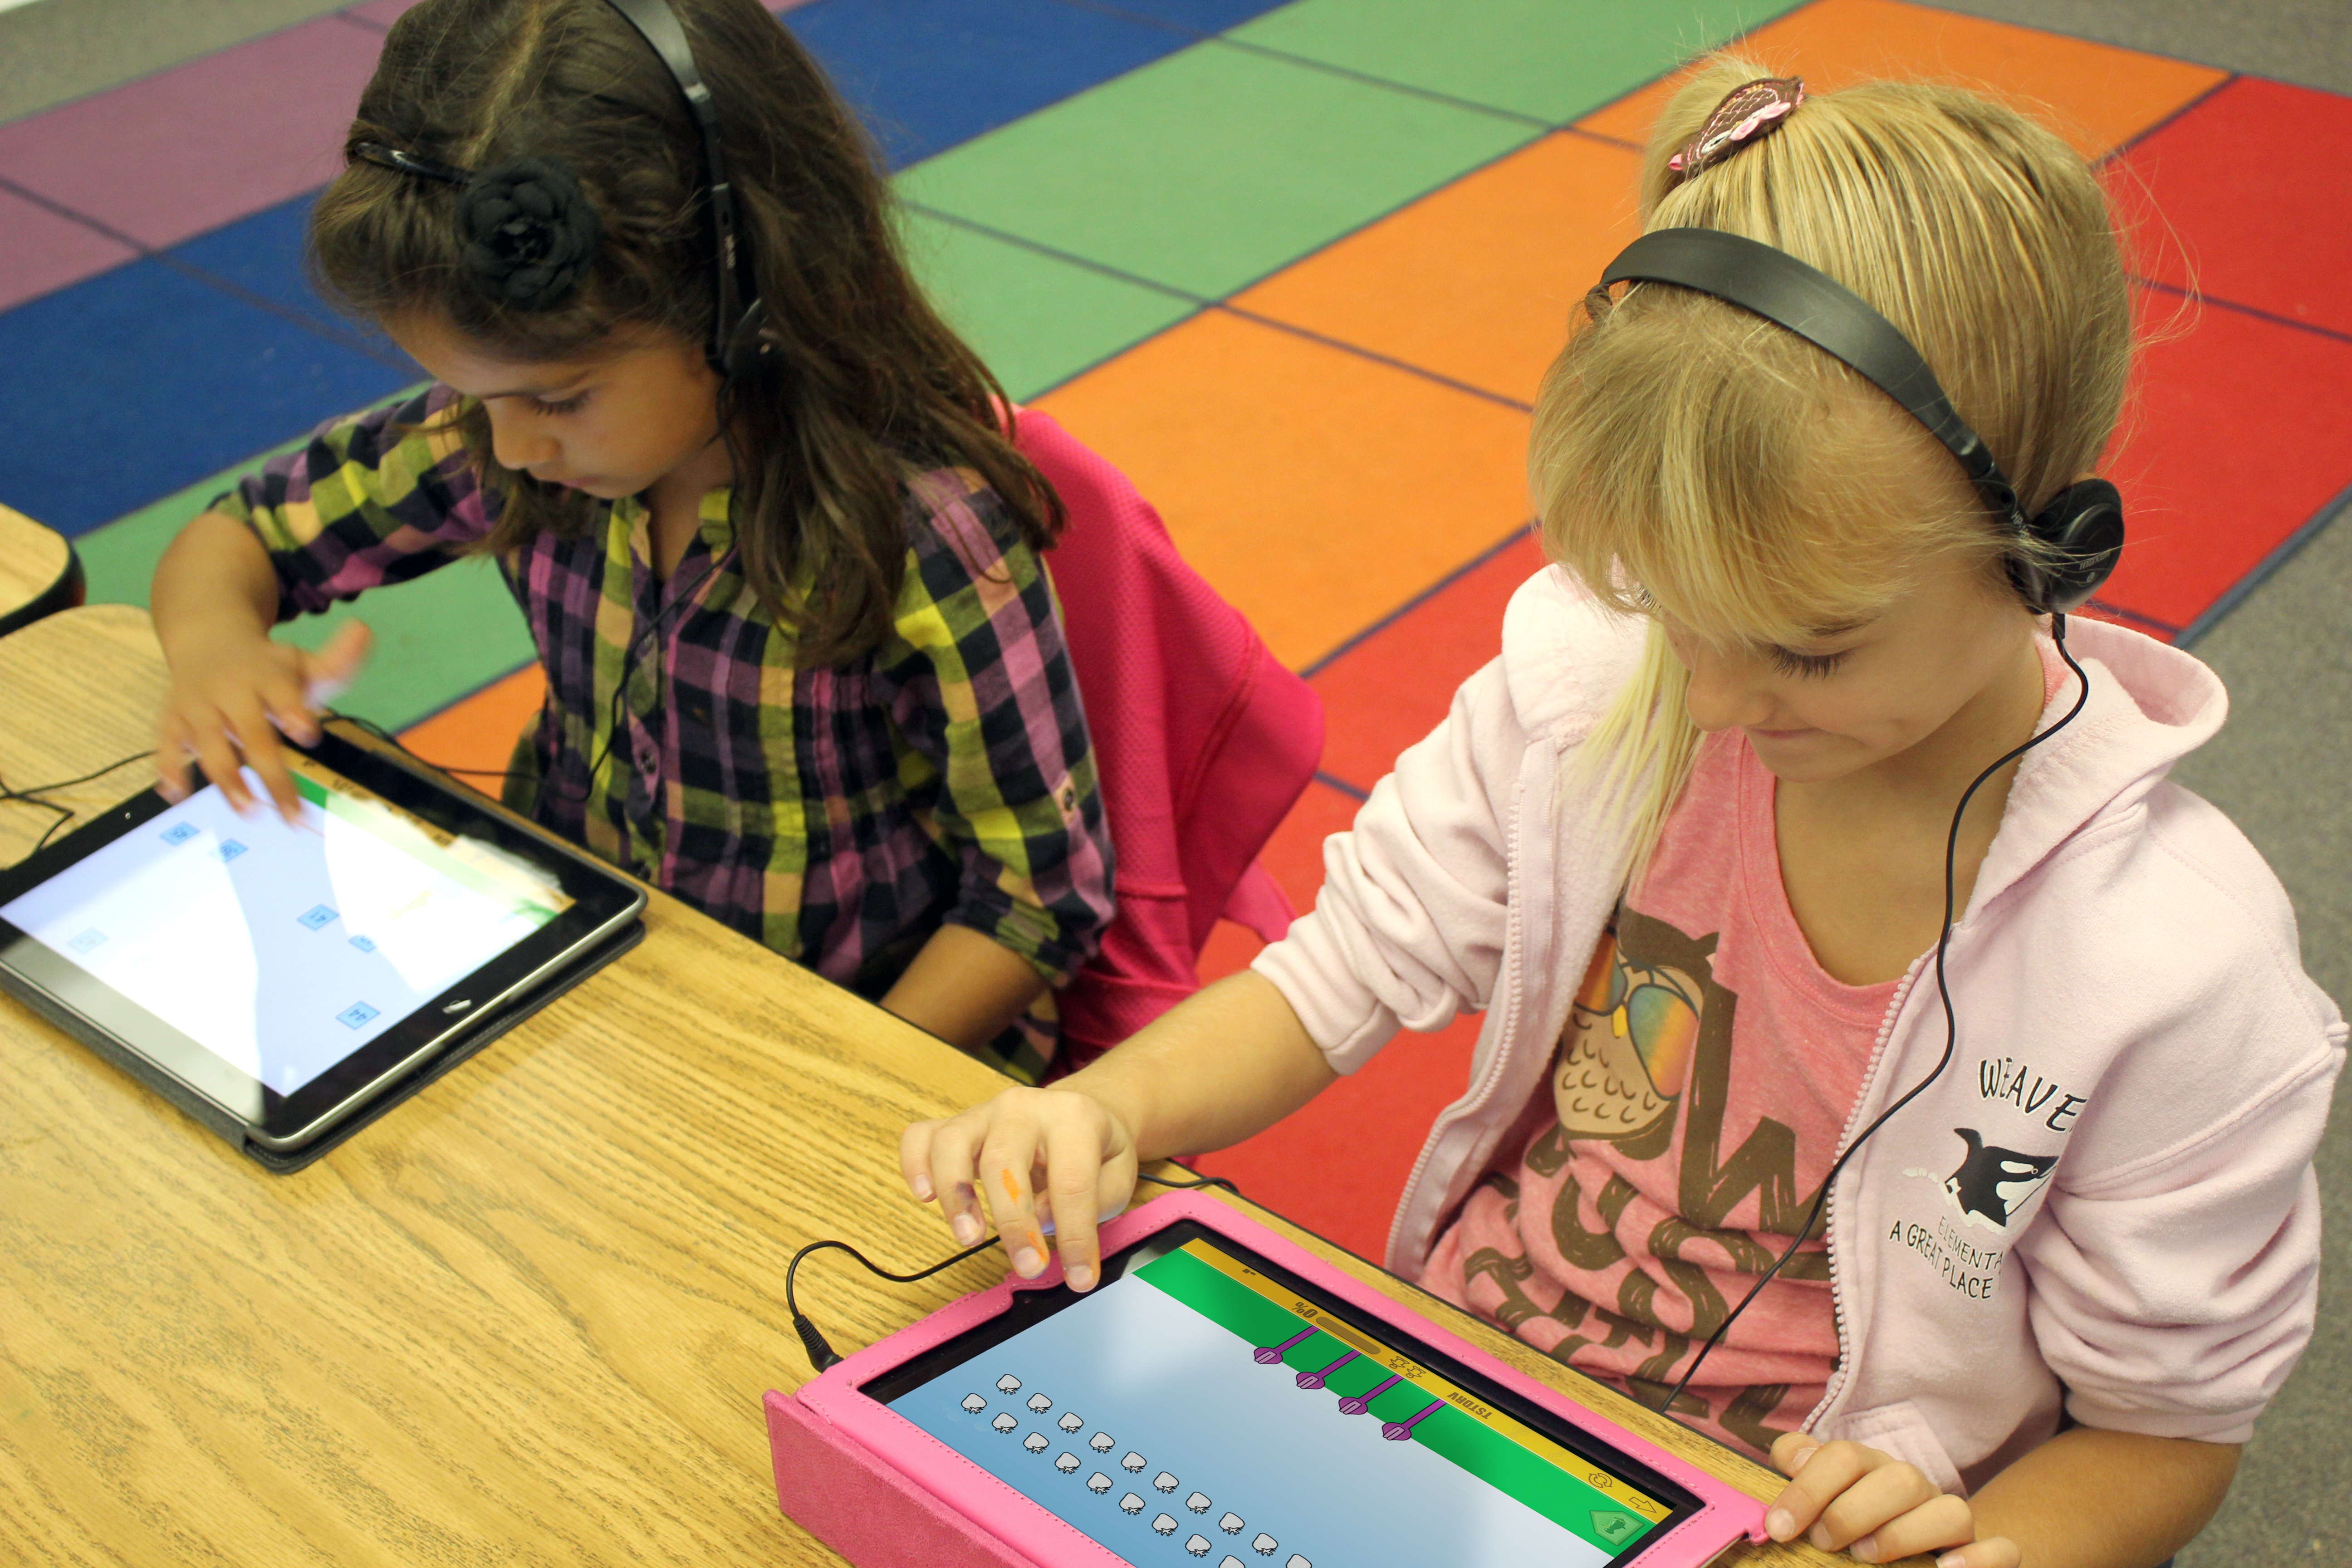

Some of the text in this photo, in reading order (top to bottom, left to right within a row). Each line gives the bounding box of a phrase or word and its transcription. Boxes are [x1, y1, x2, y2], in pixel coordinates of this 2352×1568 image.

[1980, 1056, 2088, 1133] WEAVE
[1889, 1220, 1901, 1242] A
[1906, 1223, 1943, 1270] GREAT
[1941, 1257, 1994, 1299] PLACE
[1938, 1215, 2004, 1275] ELEMENTA
[1291, 1301, 1318, 1318] 0%
[1446, 1392, 1493, 1420] TSTDRV
